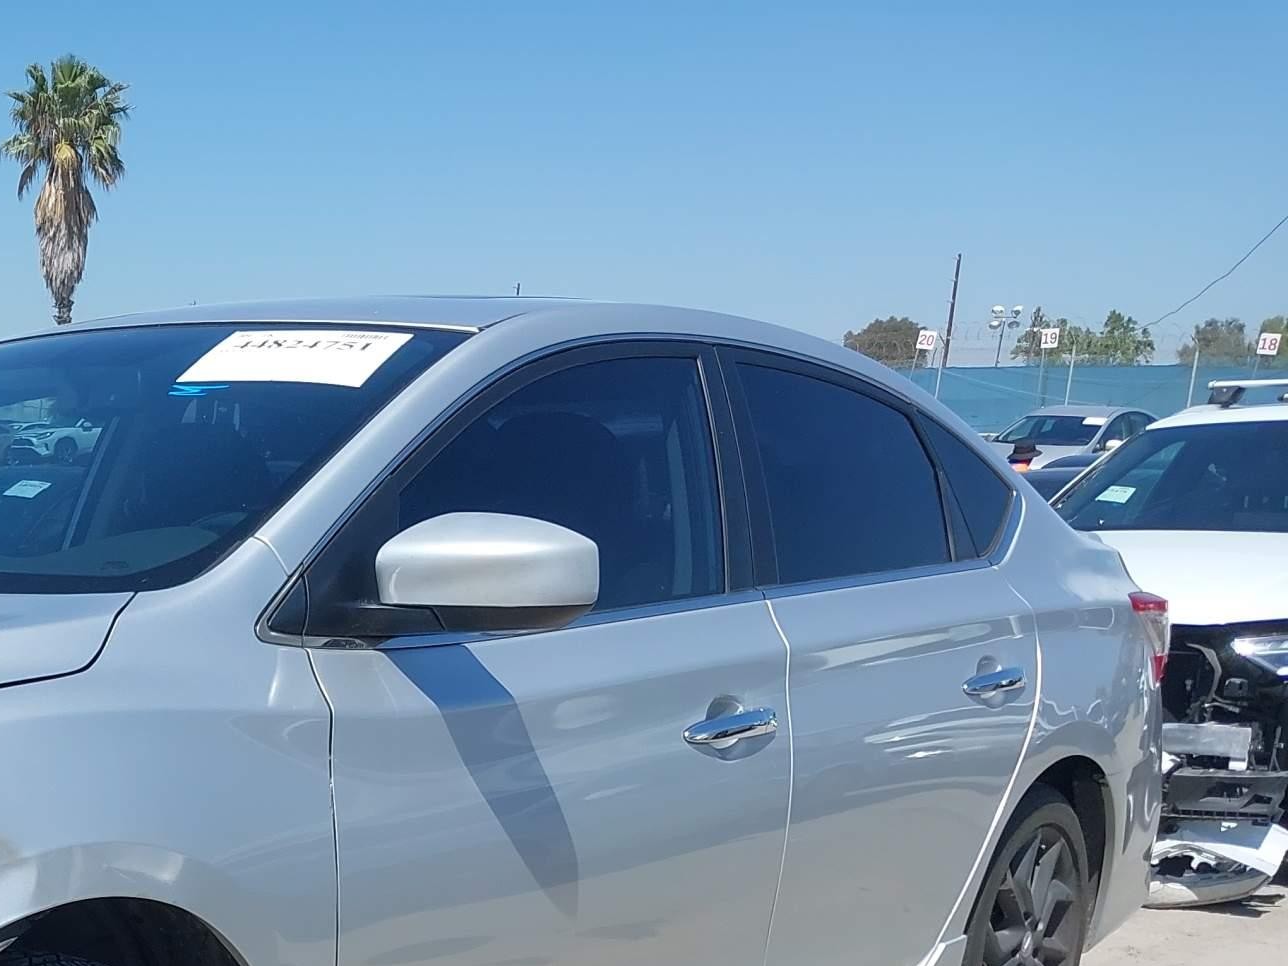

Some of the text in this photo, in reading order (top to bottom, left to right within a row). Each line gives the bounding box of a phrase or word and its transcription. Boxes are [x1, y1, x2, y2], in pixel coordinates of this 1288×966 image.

[918, 334, 936, 346] 20
[1042, 332, 1058, 345] 19
[1259, 337, 1278, 351] 18
[232, 339, 373, 351] 44824751
